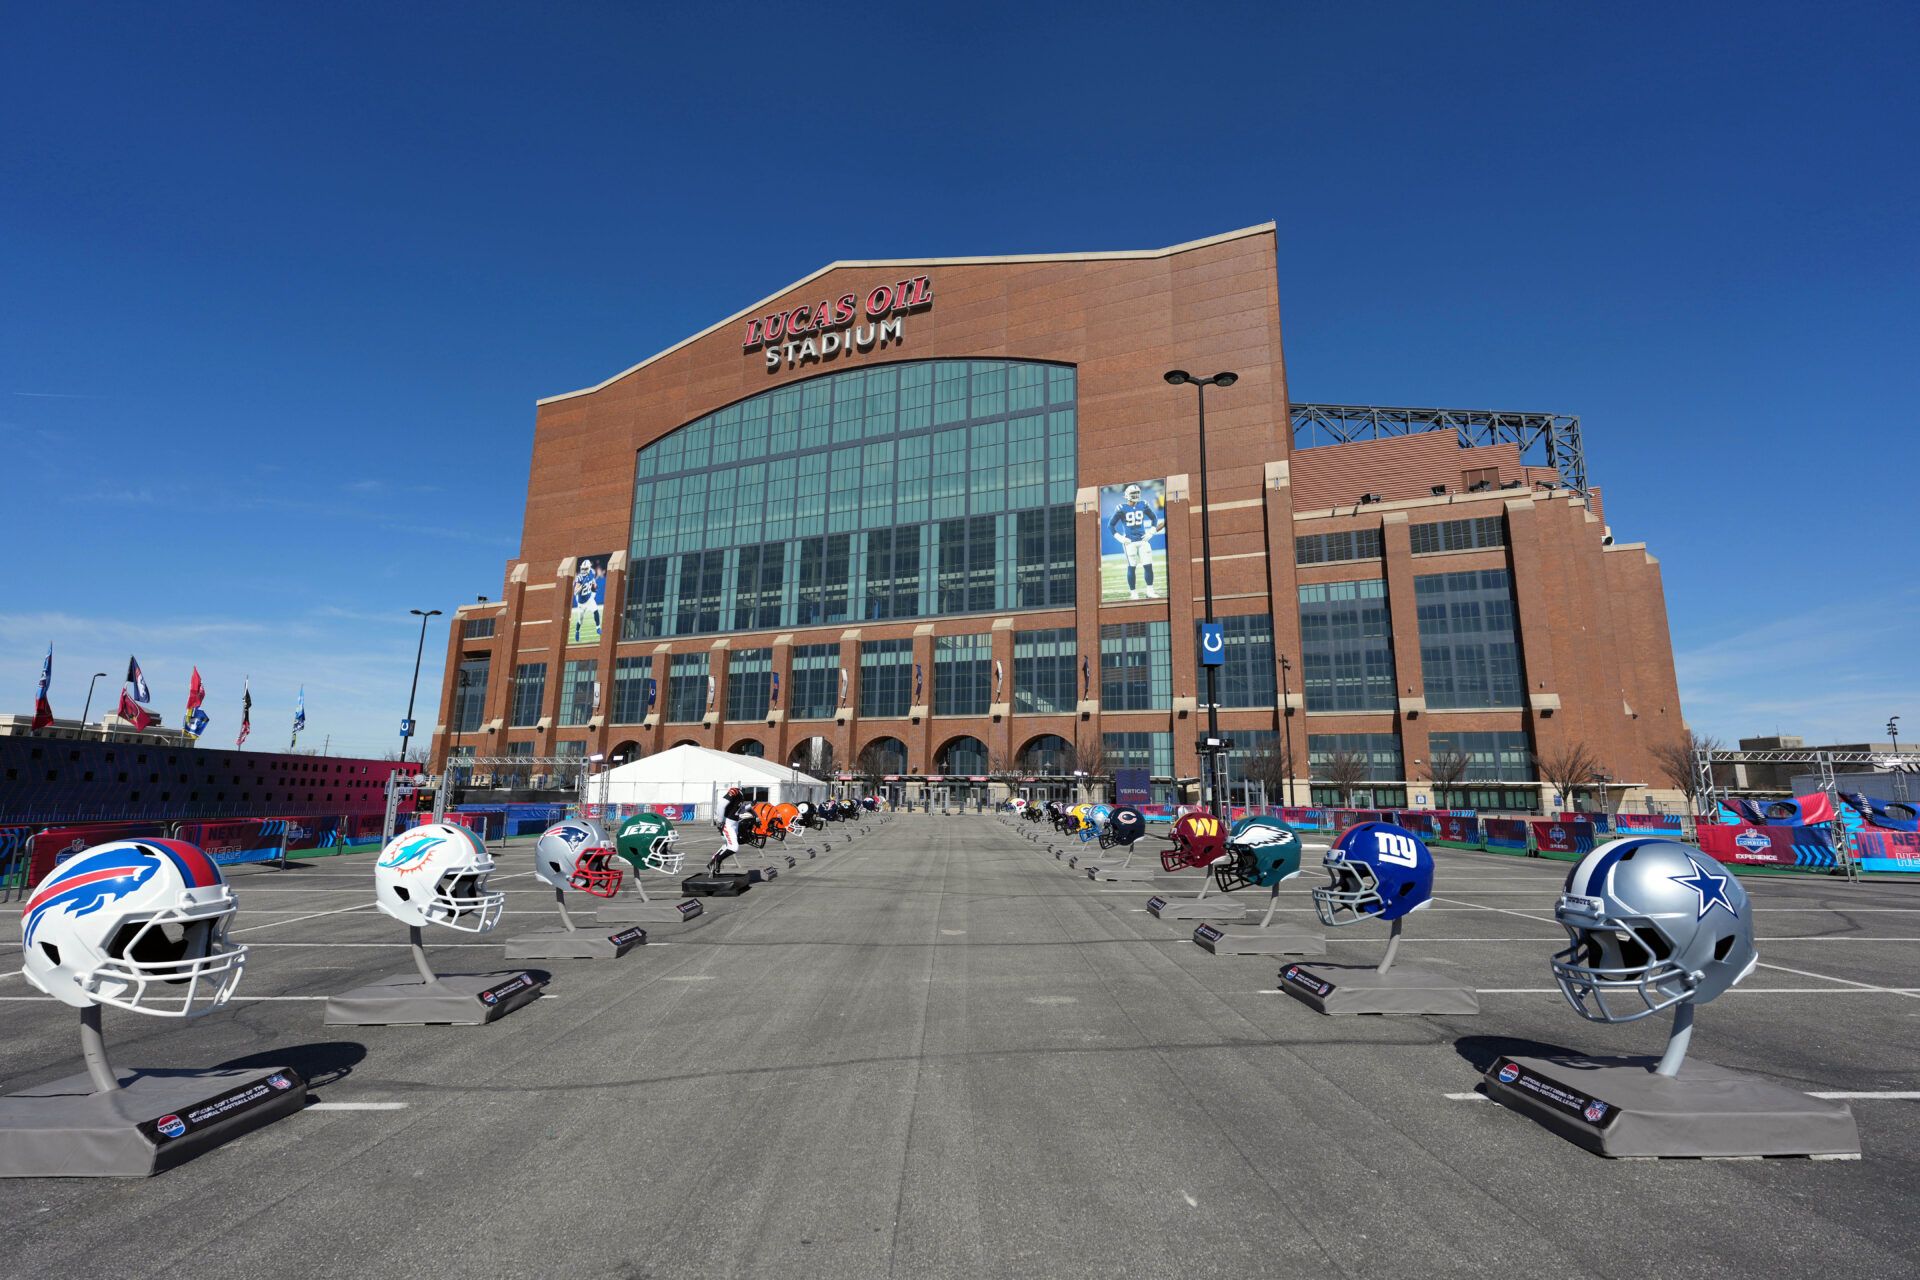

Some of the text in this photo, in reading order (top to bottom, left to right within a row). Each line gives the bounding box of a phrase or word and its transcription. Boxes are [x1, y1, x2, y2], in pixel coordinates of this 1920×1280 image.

[742, 275, 932, 347] LUCAS OIL
[765, 316, 902, 366] STADIUM
[1125, 510, 1144, 527] 99
[620, 821, 661, 838] JETS
[1738, 839, 1769, 847] COMBINE
[1735, 853, 1778, 861] EXPERIENCE
[1502, 1068, 1517, 1079] PEPSI
[1541, 1089, 1563, 1102] FOOTBALL
[188, 1105, 214, 1119] OFFICIAL
[214, 1099, 230, 1109] SOFT
[192, 1087, 270, 1123] NATIONAL FOOTBALL LEAGUE
[1587, 1108, 1602, 1119] NFL
[159, 1121, 182, 1132] PEPSI
